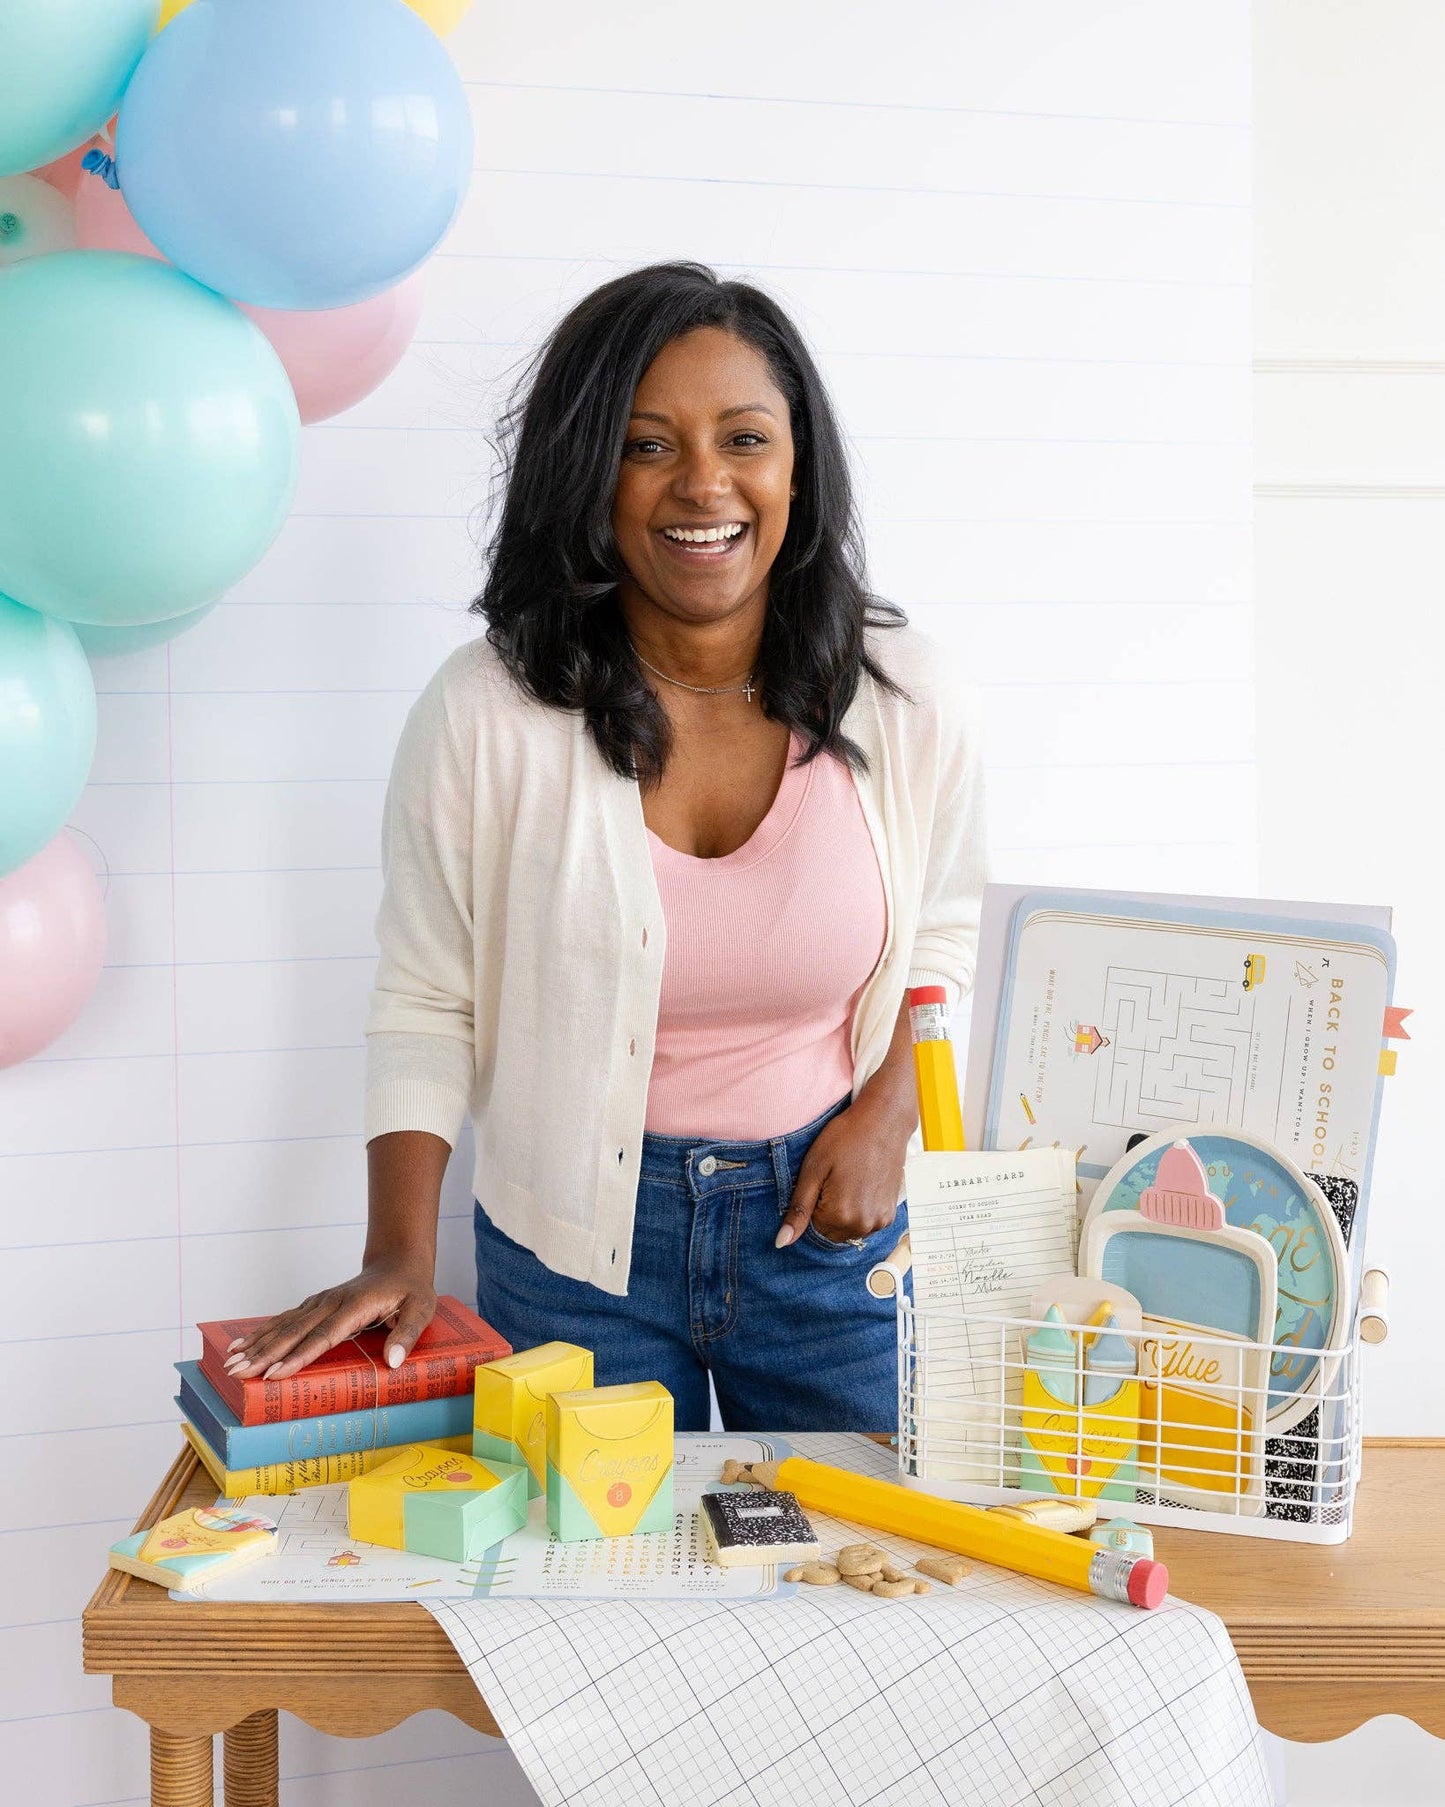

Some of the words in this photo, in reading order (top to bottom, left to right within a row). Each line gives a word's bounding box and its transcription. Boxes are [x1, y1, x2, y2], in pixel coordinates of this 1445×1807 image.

[1306, 1000, 1314, 1025] WHEN
[1327, 978, 1344, 1032] BACK
[1303, 1037, 1311, 1062] GROW
[1322, 1046, 1337, 1071] TO
[1301, 1066, 1308, 1077] UP
[1297, 1089, 1305, 1113] WANT
[1296, 1117, 1302, 1128] TO
[1311, 1083, 1332, 1170] SCHOOL
[938, 1175, 990, 1189] LIBRARY
[996, 1171, 1025, 1183] CARD
[1143, 1331, 1222, 1390] Glue
[302, 1380, 311, 1417] WOMAN
[320, 1385, 328, 1408] FAITH
[402, 1455, 465, 1489] Crayons
[578, 1448, 659, 1483] Crayons
[614, 1488, 624, 1502] 8
